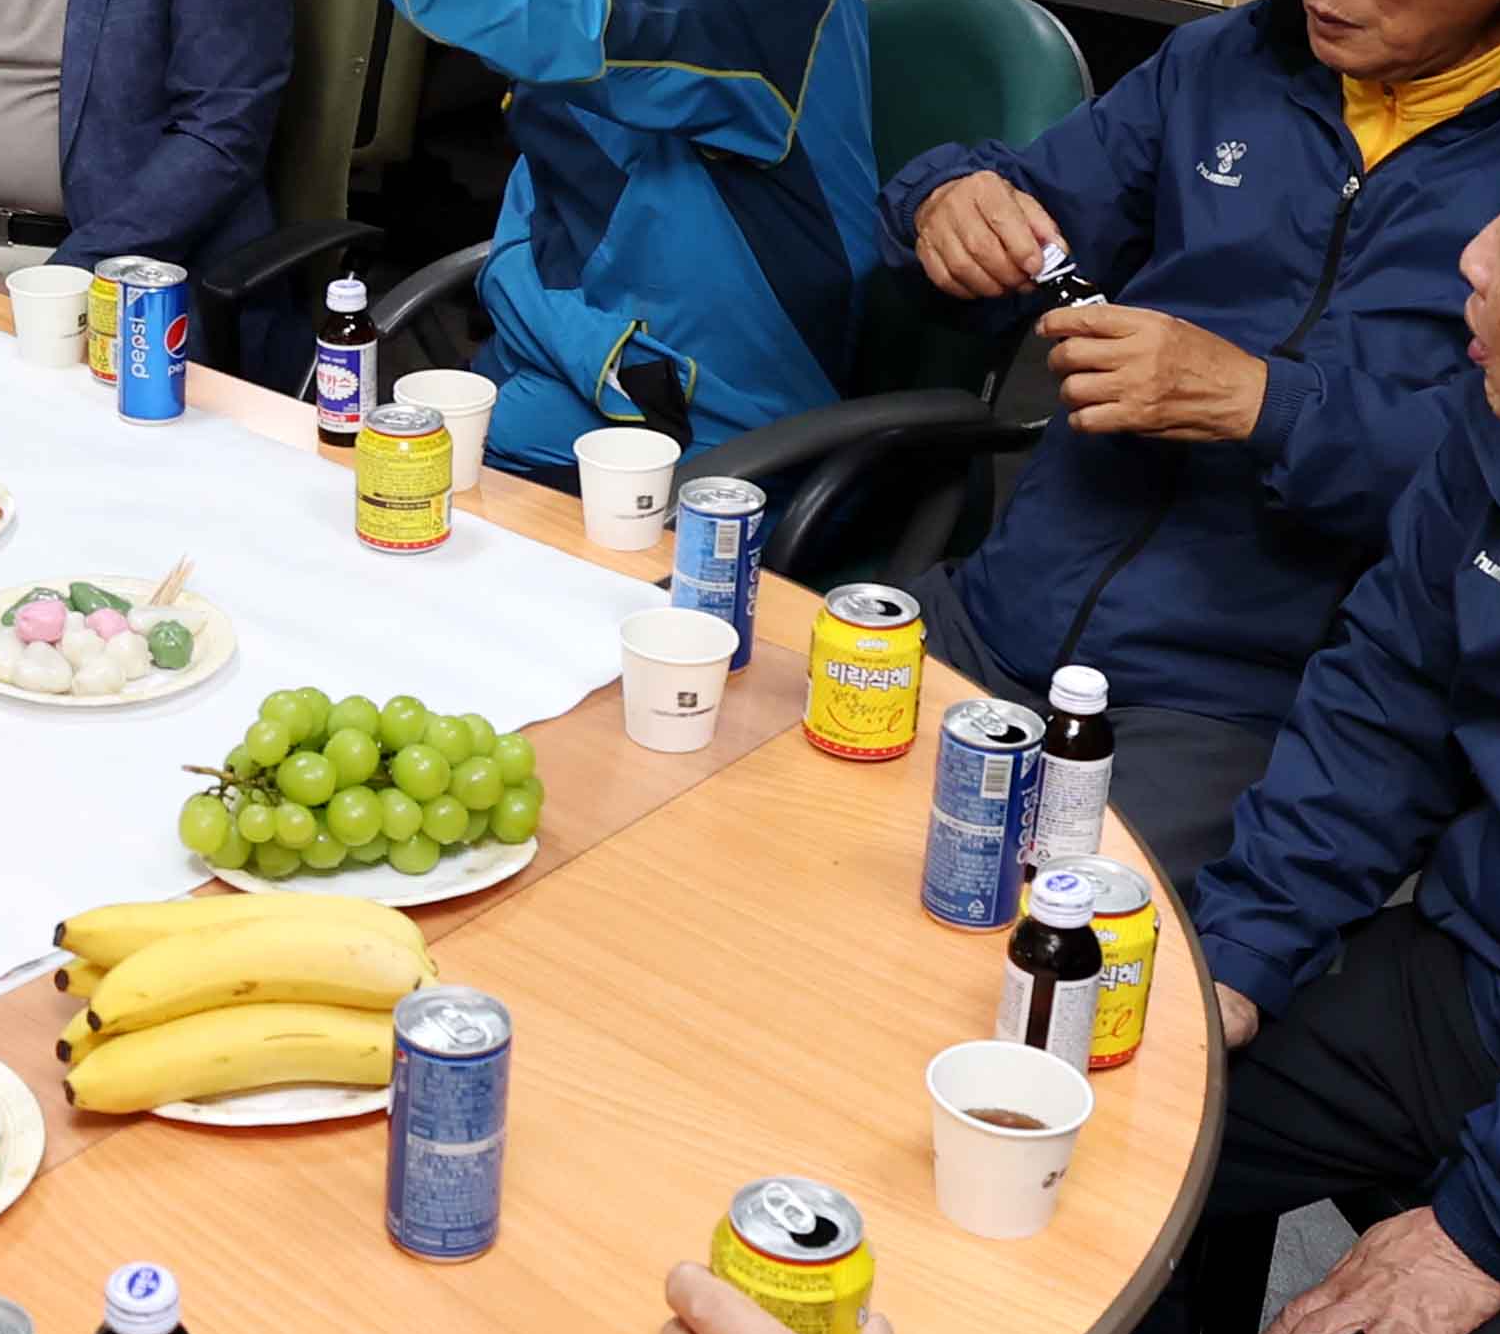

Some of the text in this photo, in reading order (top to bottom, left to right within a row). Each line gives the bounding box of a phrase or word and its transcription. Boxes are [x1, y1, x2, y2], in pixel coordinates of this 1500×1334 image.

[1196, 162, 1243, 188] hummel
[130, 317, 150, 379] pepsi
[826, 660, 911, 690] 비락식혜
